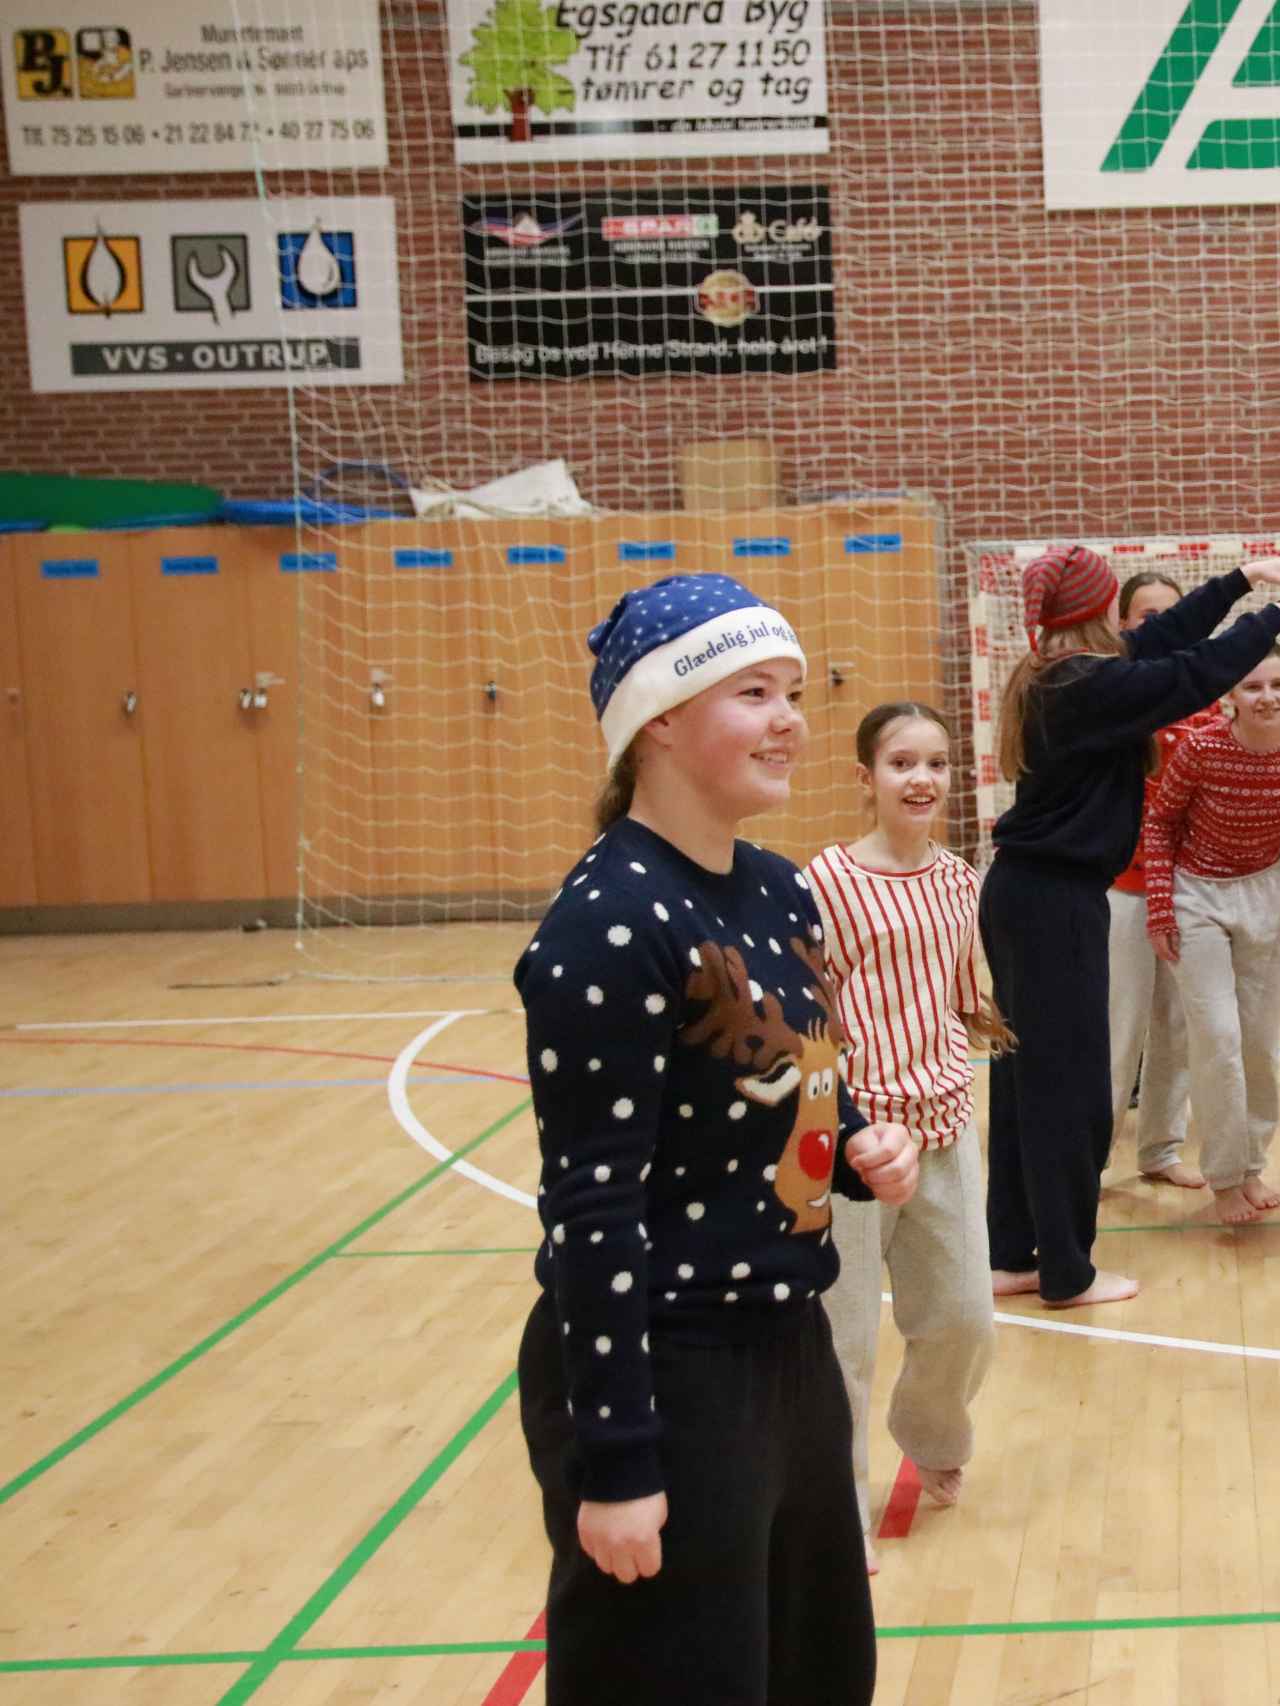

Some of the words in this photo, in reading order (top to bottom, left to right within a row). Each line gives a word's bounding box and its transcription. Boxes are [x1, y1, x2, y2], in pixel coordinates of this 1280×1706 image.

[745, 0, 808, 34] Byg
[161, 48, 232, 73] Jensen
[586, 43, 630, 73] Tlf
[645, 42, 678, 71] 61
[689, 41, 726, 70] 27
[737, 40, 762, 69] 11
[772, 39, 811, 68] 50
[582, 77, 694, 102] tømrer
[708, 78, 745, 107] og
[761, 72, 812, 105] tag
[101, 346, 168, 371] VVS
[191, 341, 329, 368] OUTRUP
[673, 627, 749, 678] Glædelig
[747, 620, 769, 644] jul
